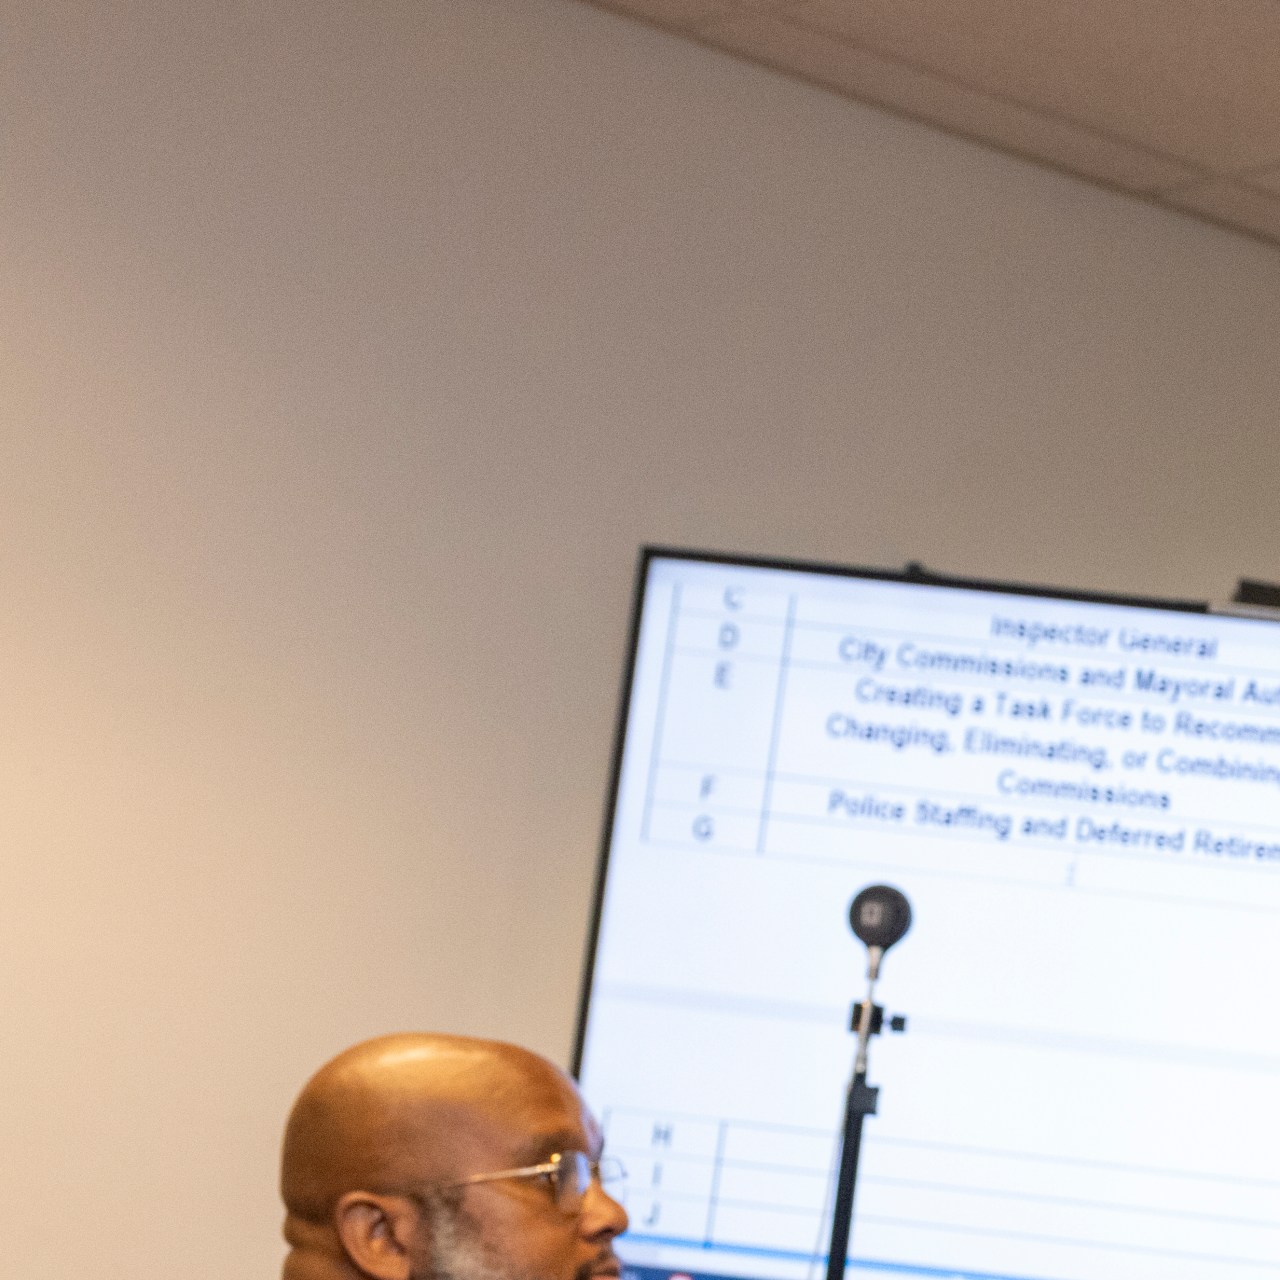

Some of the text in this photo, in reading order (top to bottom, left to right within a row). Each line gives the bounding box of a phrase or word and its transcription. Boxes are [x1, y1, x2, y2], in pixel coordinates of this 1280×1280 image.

[990, 615, 1218, 658] Inspector General
[838, 636, 887, 672] City
[897, 642, 1068, 684] Commissions
[1079, 666, 1124, 691] and
[1135, 667, 1235, 702] Mayoral
[855, 677, 963, 718] Creating
[972, 695, 984, 714] a
[997, 692, 1050, 720] Task
[1060, 699, 1133, 730] Force
[1142, 710, 1166, 735] to
[1122, 749, 1148, 769] or
[998, 768, 1171, 811] Commissions
[828, 788, 905, 821] Police
[914, 799, 1012, 842] Staffing
[1021, 816, 1067, 842] and
[1075, 815, 1186, 852] Deferred
